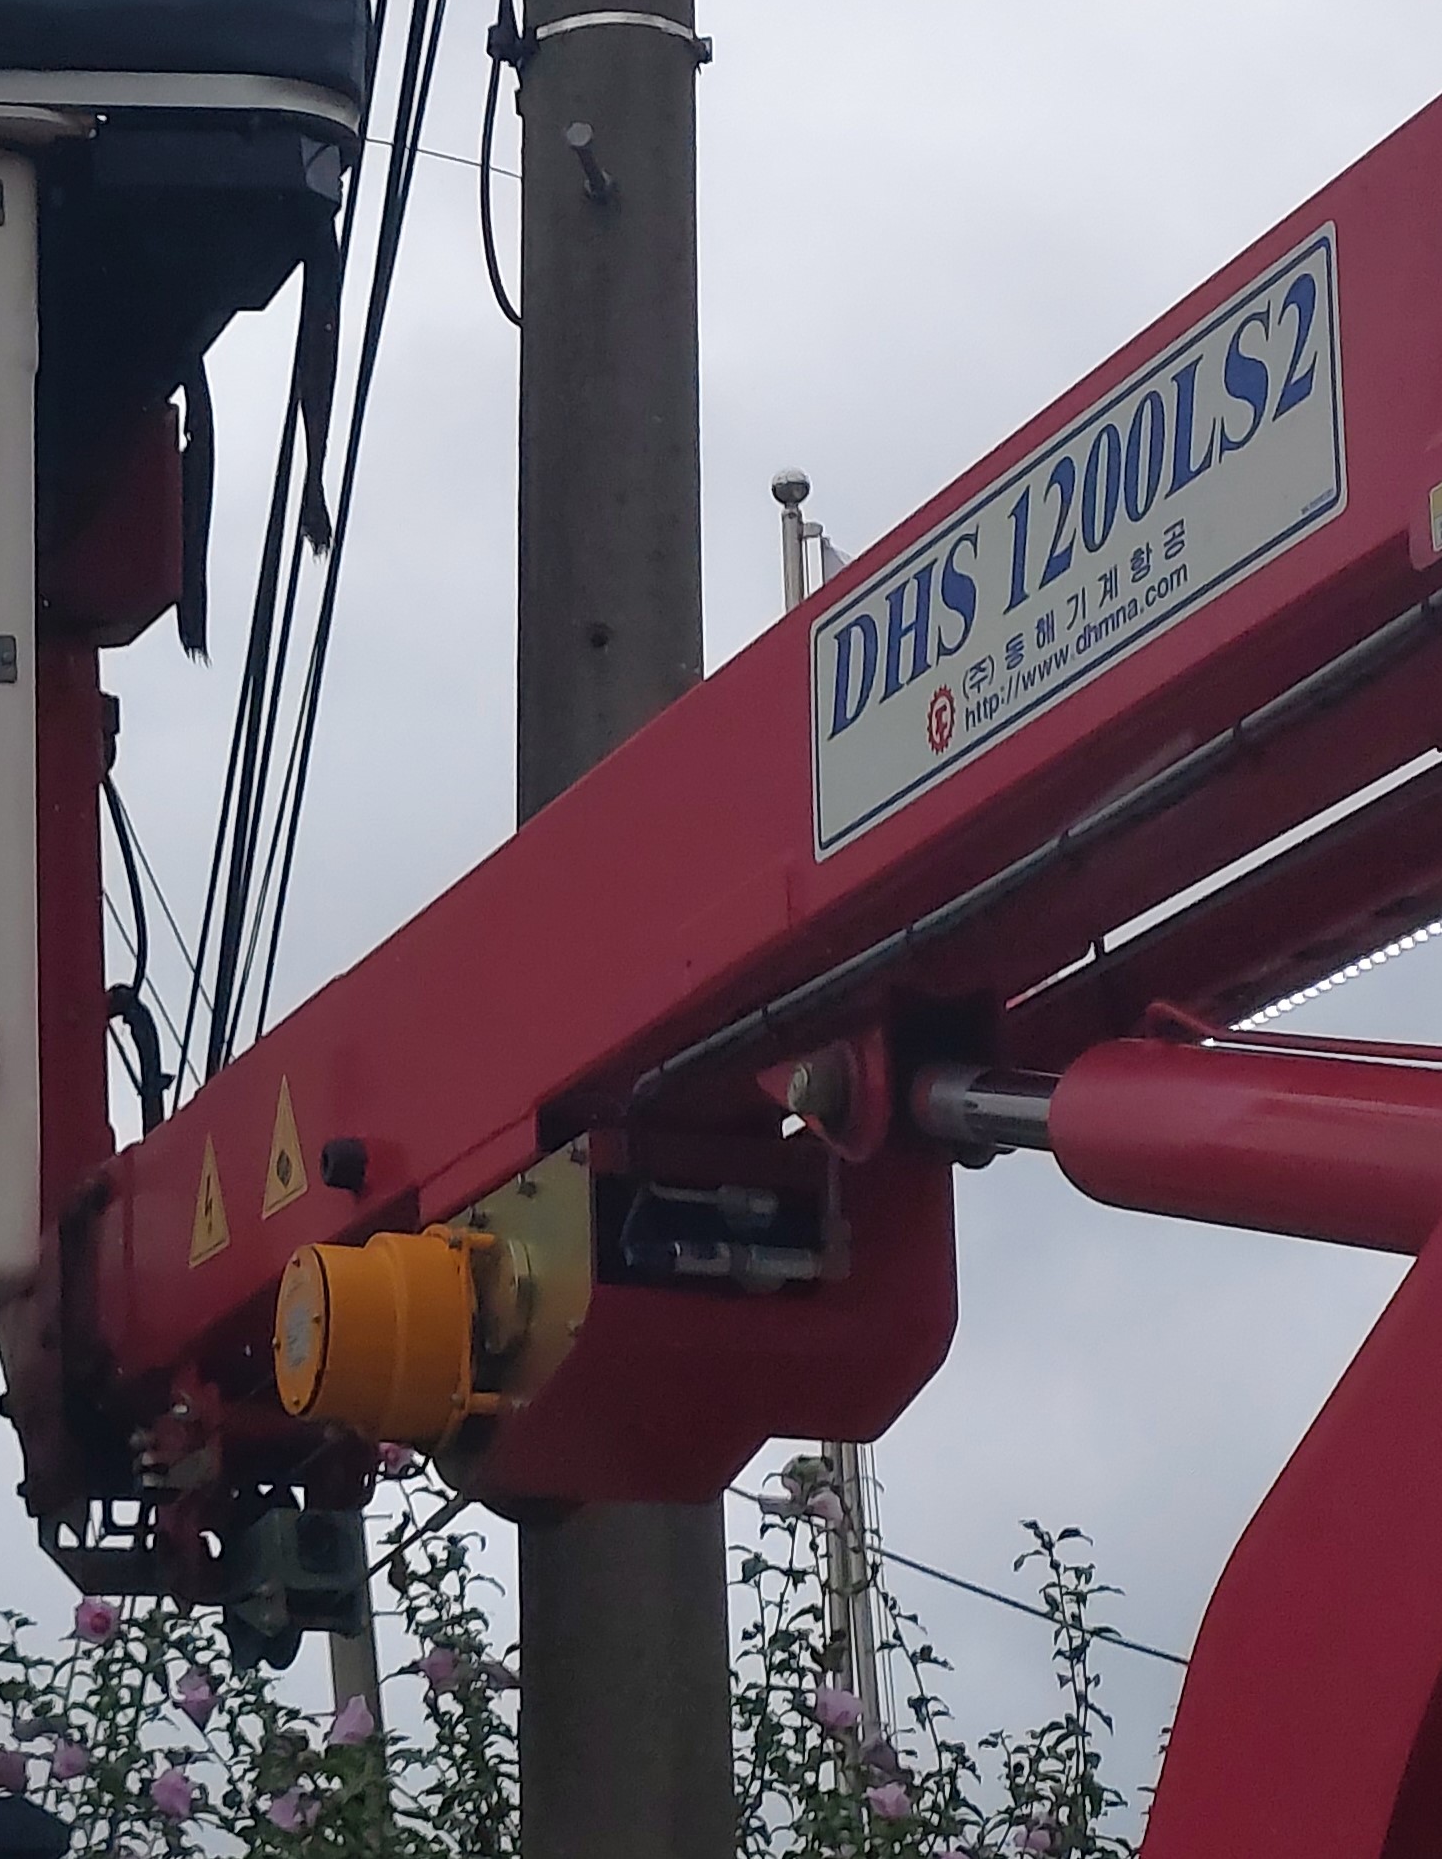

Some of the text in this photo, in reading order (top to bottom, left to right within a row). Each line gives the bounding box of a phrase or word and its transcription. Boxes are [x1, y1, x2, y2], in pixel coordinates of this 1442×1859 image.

[827, 273, 1318, 741] DHS 1200LS2
[964, 562, 1189, 732] http://www.dhmna.com
